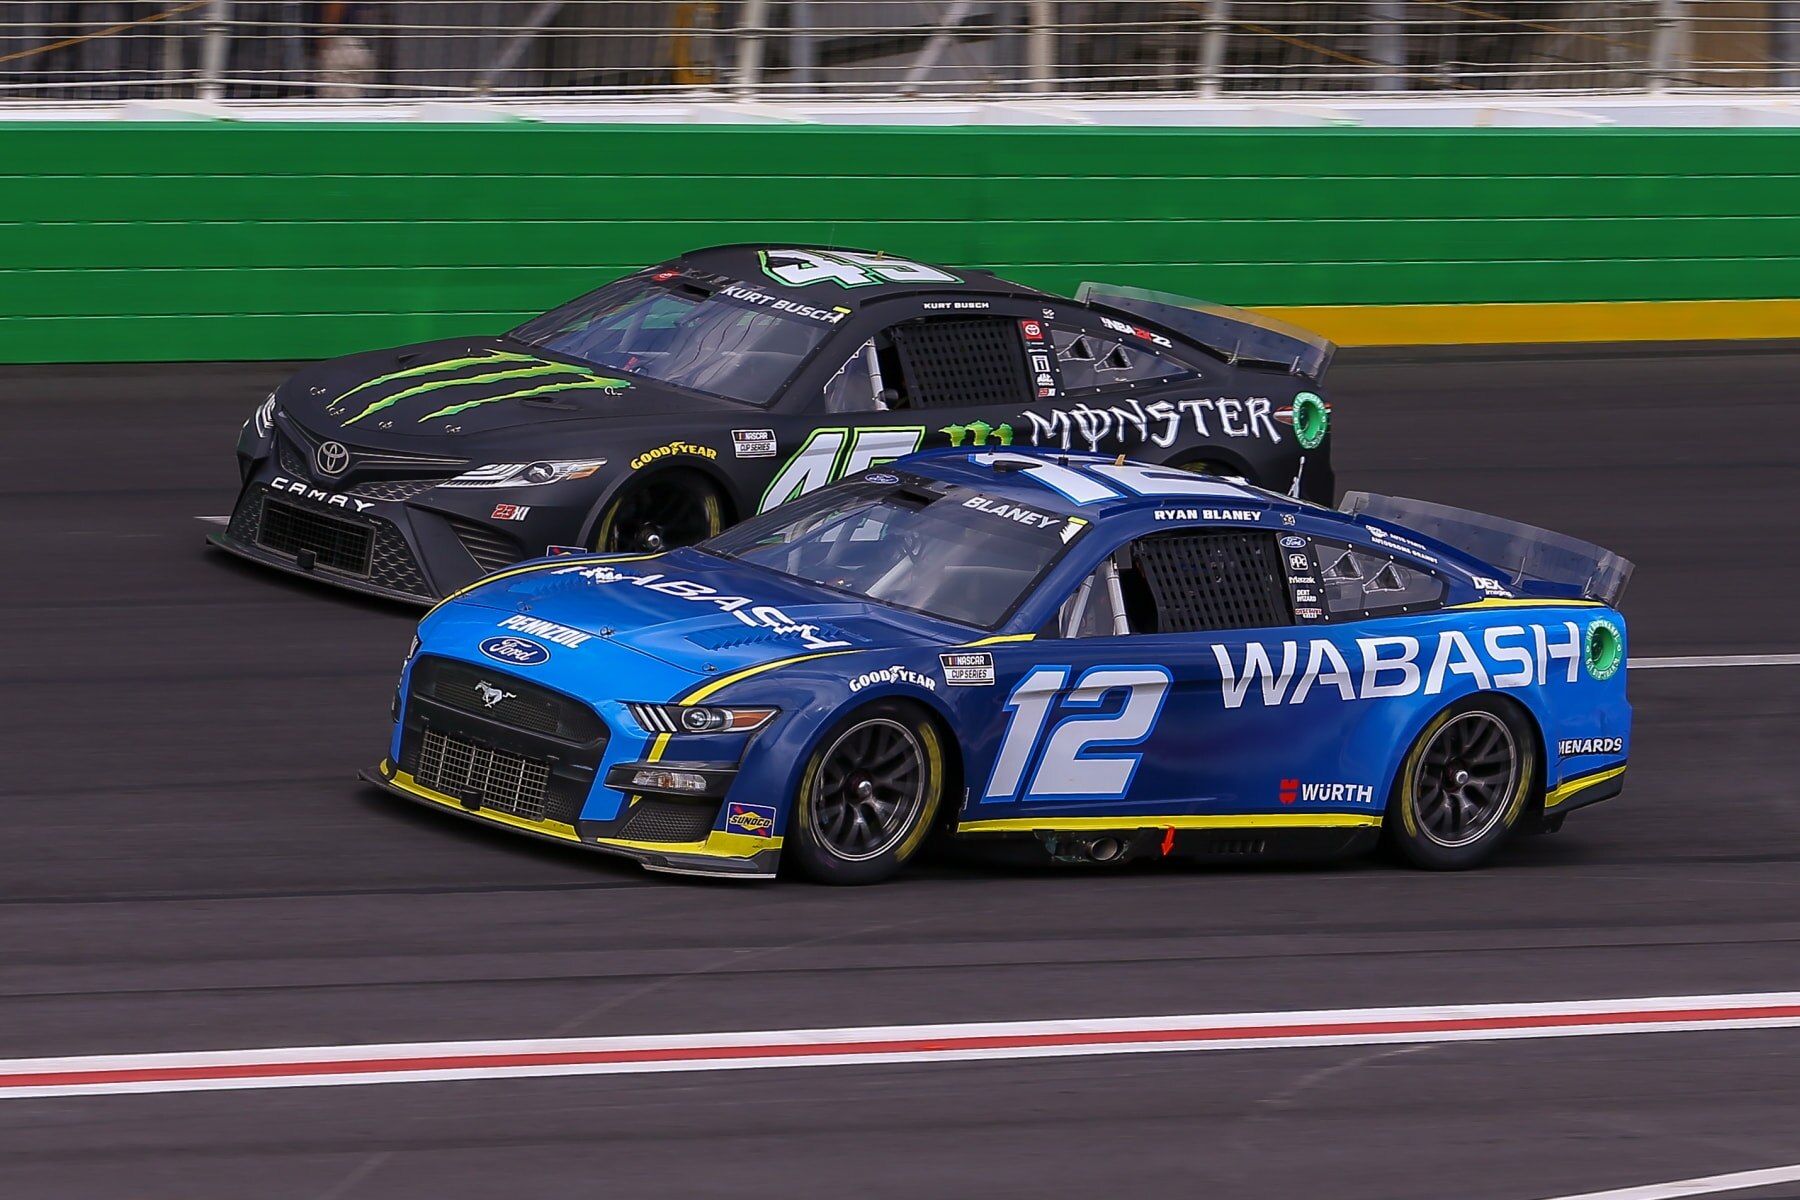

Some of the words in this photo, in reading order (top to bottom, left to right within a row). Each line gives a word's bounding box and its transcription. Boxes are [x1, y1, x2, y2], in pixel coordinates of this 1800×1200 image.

[757, 249, 965, 289] 45
[721, 285, 776, 306] KURT
[771, 299, 845, 325] BUSCH
[745, 432, 768, 440] NASCAR
[1021, 397, 1282, 453] MONSTER
[630, 441, 718, 471] GOODYEAR
[751, 443, 771, 451] SERIES
[962, 497, 1060, 530] BLANEY
[1154, 510, 1198, 521] RYAN
[1202, 510, 1262, 521] BLANEY
[1472, 576, 1505, 591] DEX
[496, 614, 592, 649] PENNZOIL
[489, 638, 539, 661] Ford
[957, 656, 985, 665] NASCAR
[849, 665, 937, 693] GOODYEAR
[951, 670, 964, 678] CUP
[965, 670, 987, 678] SERIES
[1211, 622, 1581, 709] WABASH
[980, 664, 1174, 804] 12
[731, 815, 771, 827] SUNOCO
